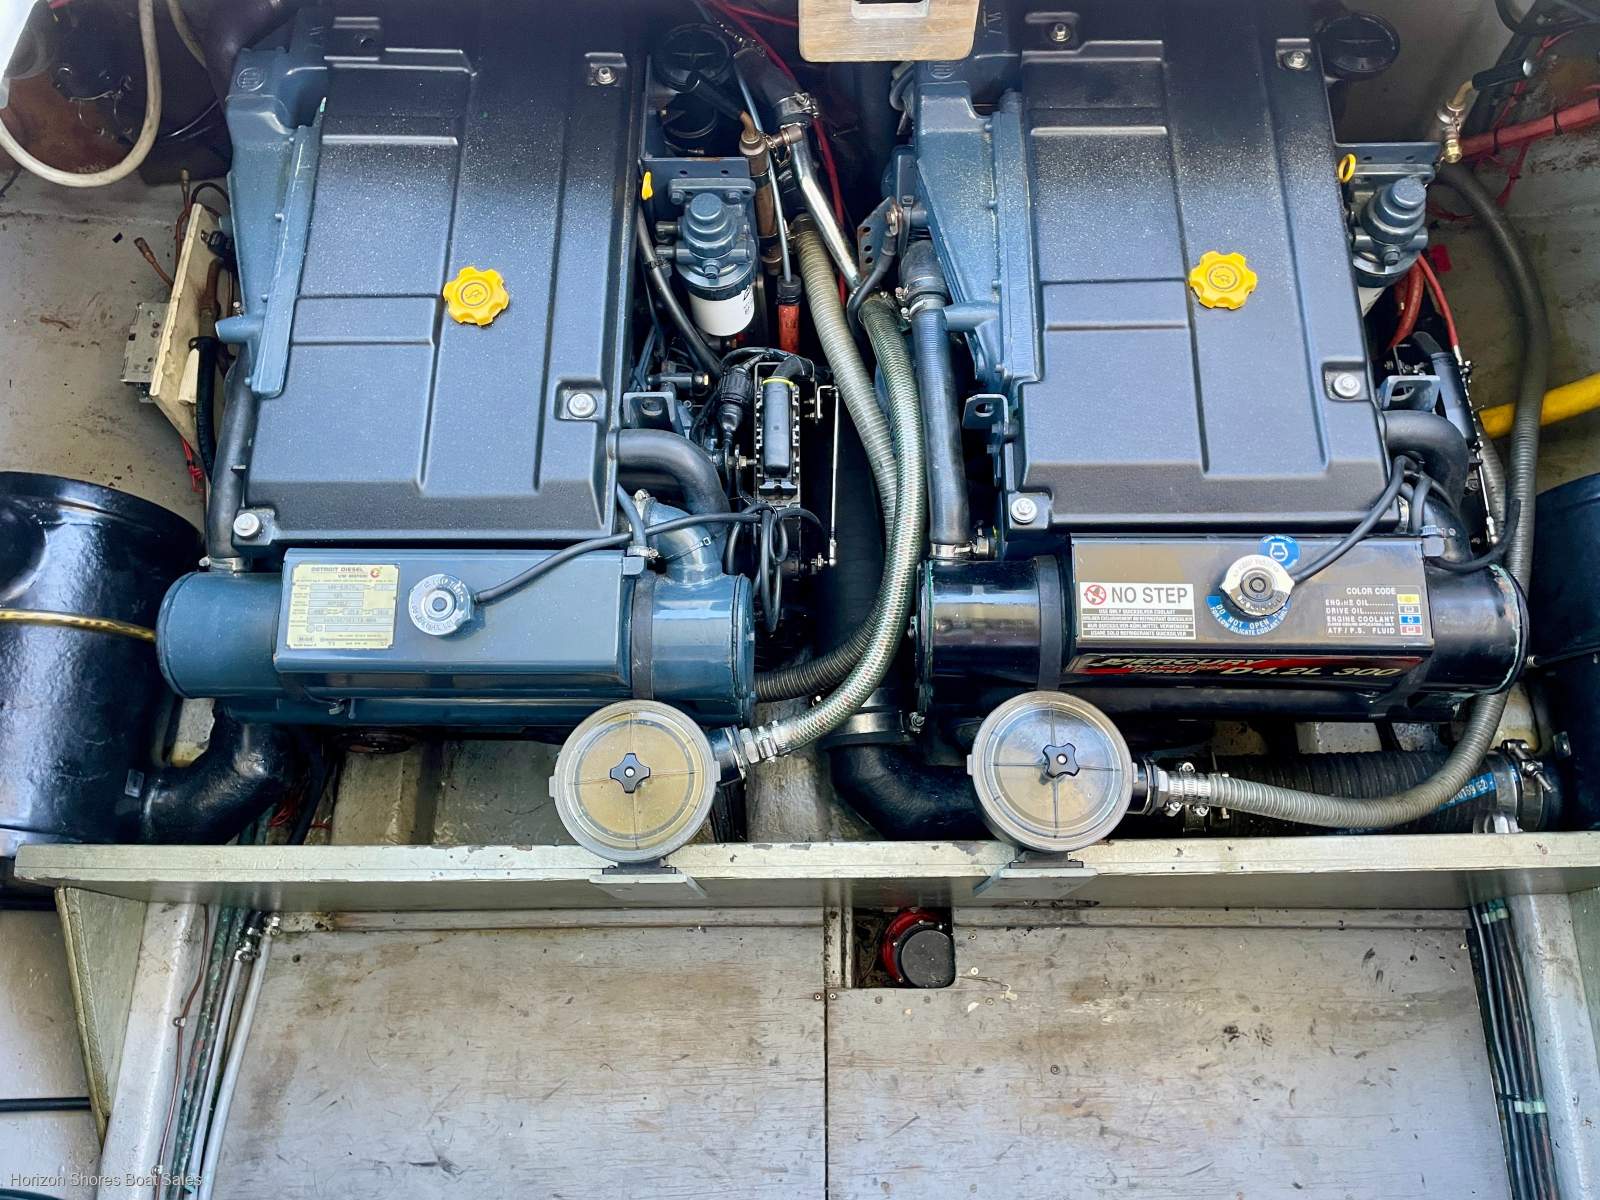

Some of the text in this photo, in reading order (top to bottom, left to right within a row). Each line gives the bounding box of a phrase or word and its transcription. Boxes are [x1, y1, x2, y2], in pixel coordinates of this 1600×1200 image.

[1111, 586, 1188, 603] NO STEP
[1346, 587, 1397, 595] COLOR CODE
[1216, 604, 1270, 629] DO NOT OPEN
[1218, 616, 1230, 629] LOW
[1230, 623, 1255, 636] SILICATE
[1100, 657, 1267, 666] MERCURY
[1220, 667, 1401, 676] D4.2L 300
